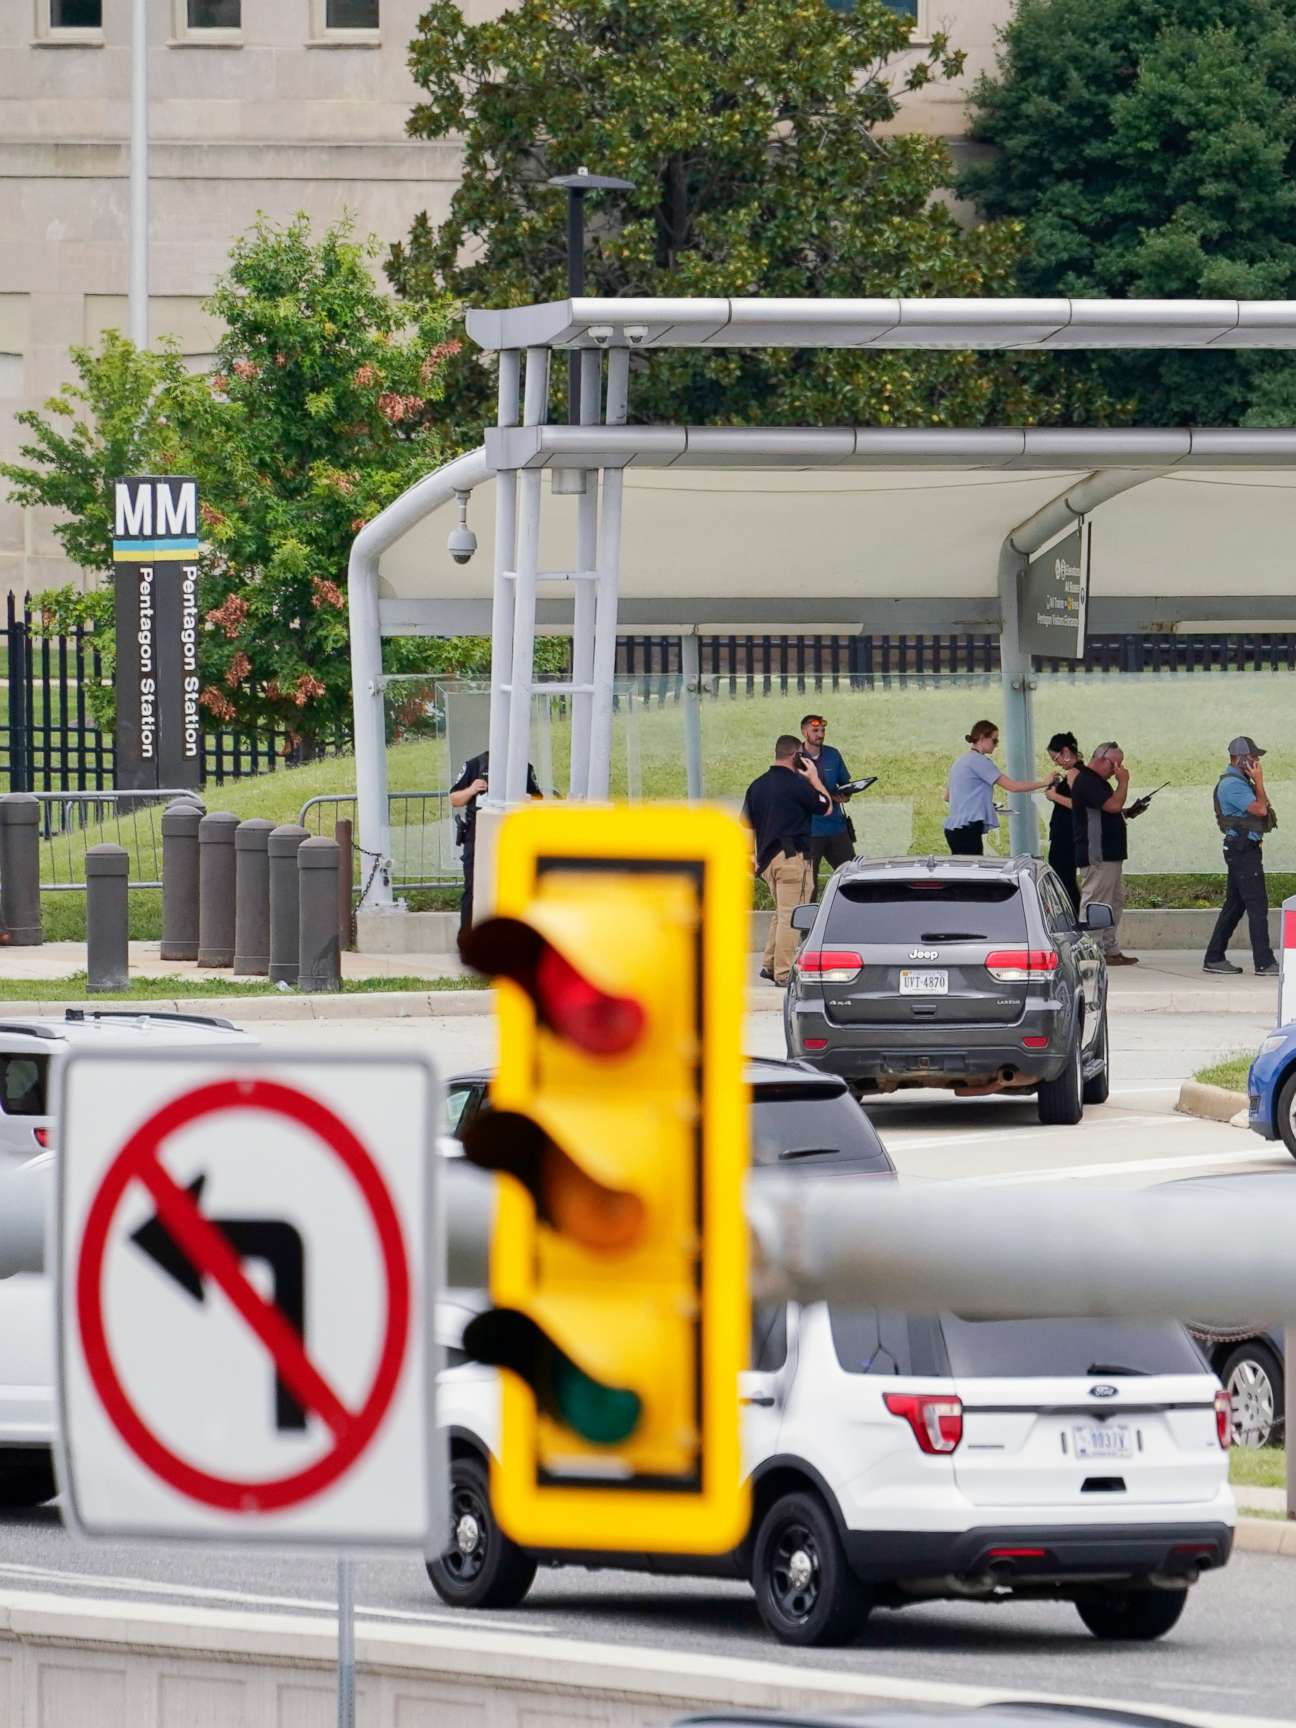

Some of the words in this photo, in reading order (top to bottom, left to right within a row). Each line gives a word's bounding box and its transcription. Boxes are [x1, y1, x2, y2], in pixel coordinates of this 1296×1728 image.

[138, 567, 155, 672] Pentagon
[181, 566, 198, 671] Pentagon
[140, 678, 156, 758] Station
[184, 676, 200, 757] Station
[909, 949, 938, 961] Jeep
